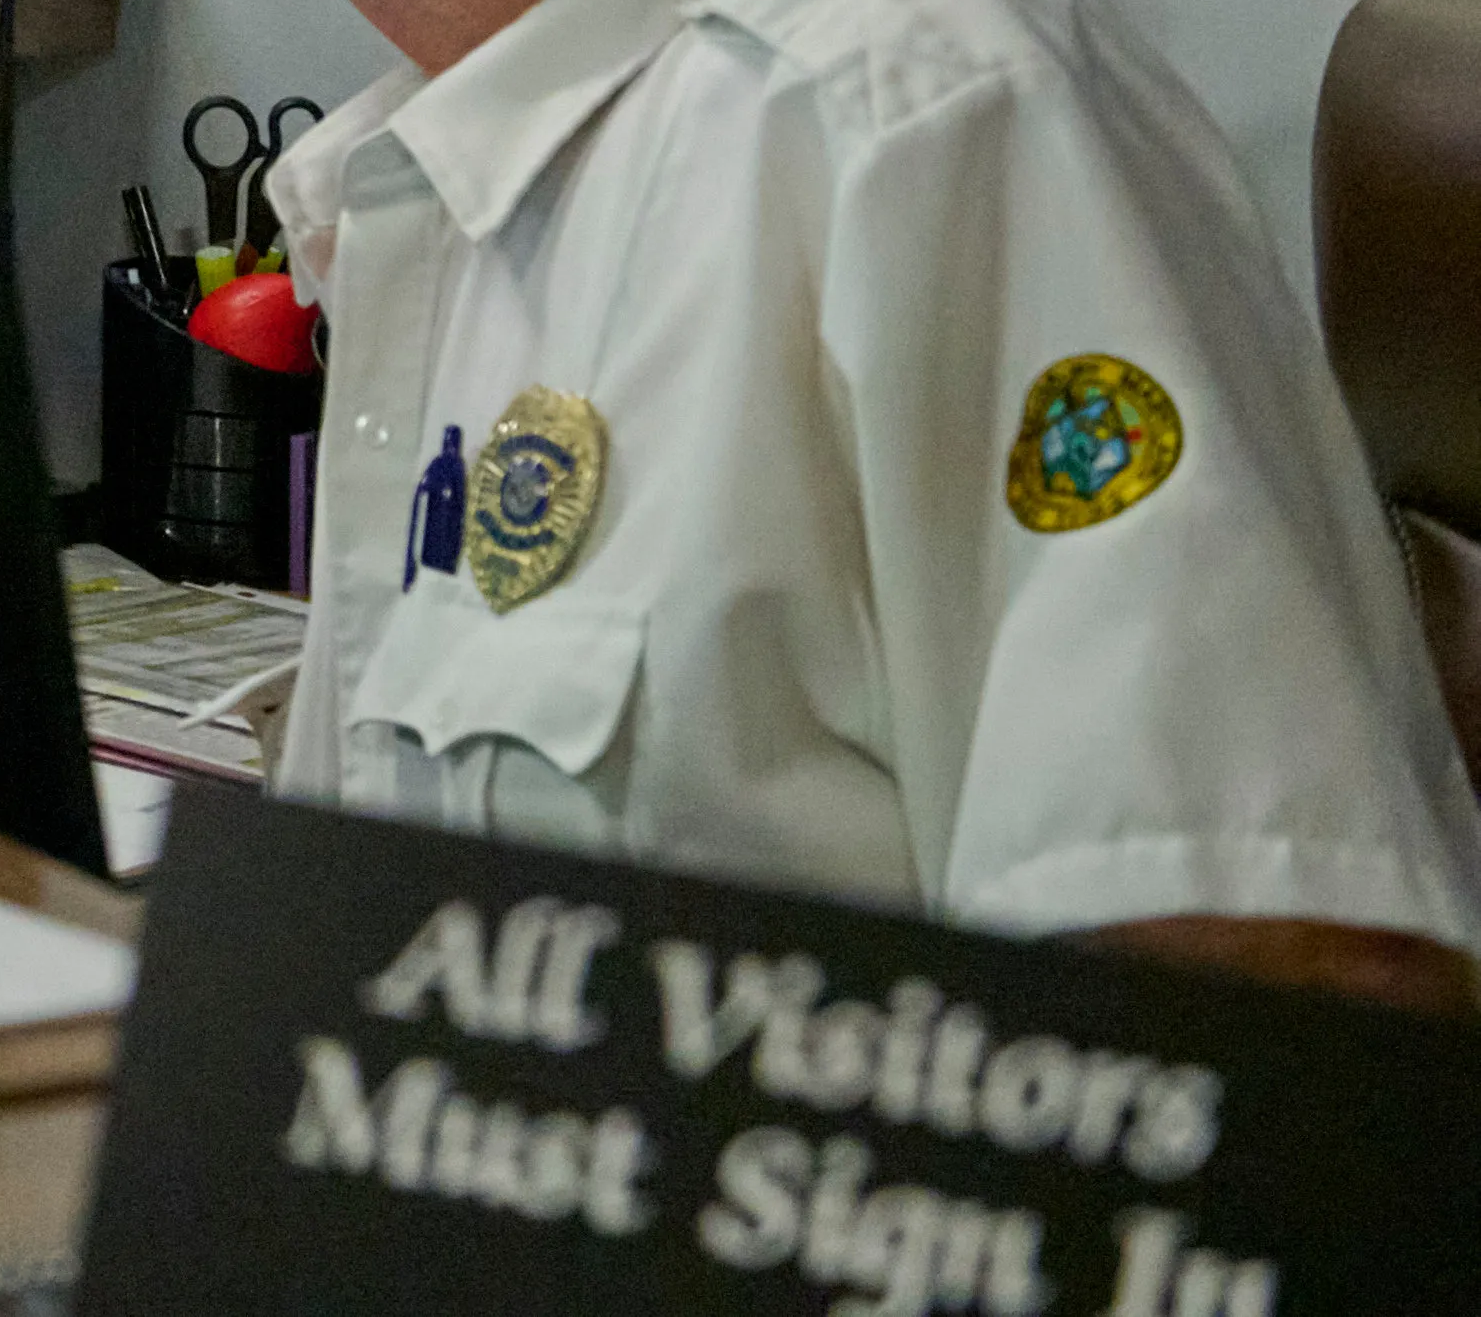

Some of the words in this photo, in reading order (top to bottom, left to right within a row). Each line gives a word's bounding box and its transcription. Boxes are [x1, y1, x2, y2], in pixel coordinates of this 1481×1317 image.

[282, 1032, 659, 1238] Must
[700, 1122, 1049, 1317] Sign
[366, 893, 622, 1053] All
[655, 935, 1227, 1180] Visitors
